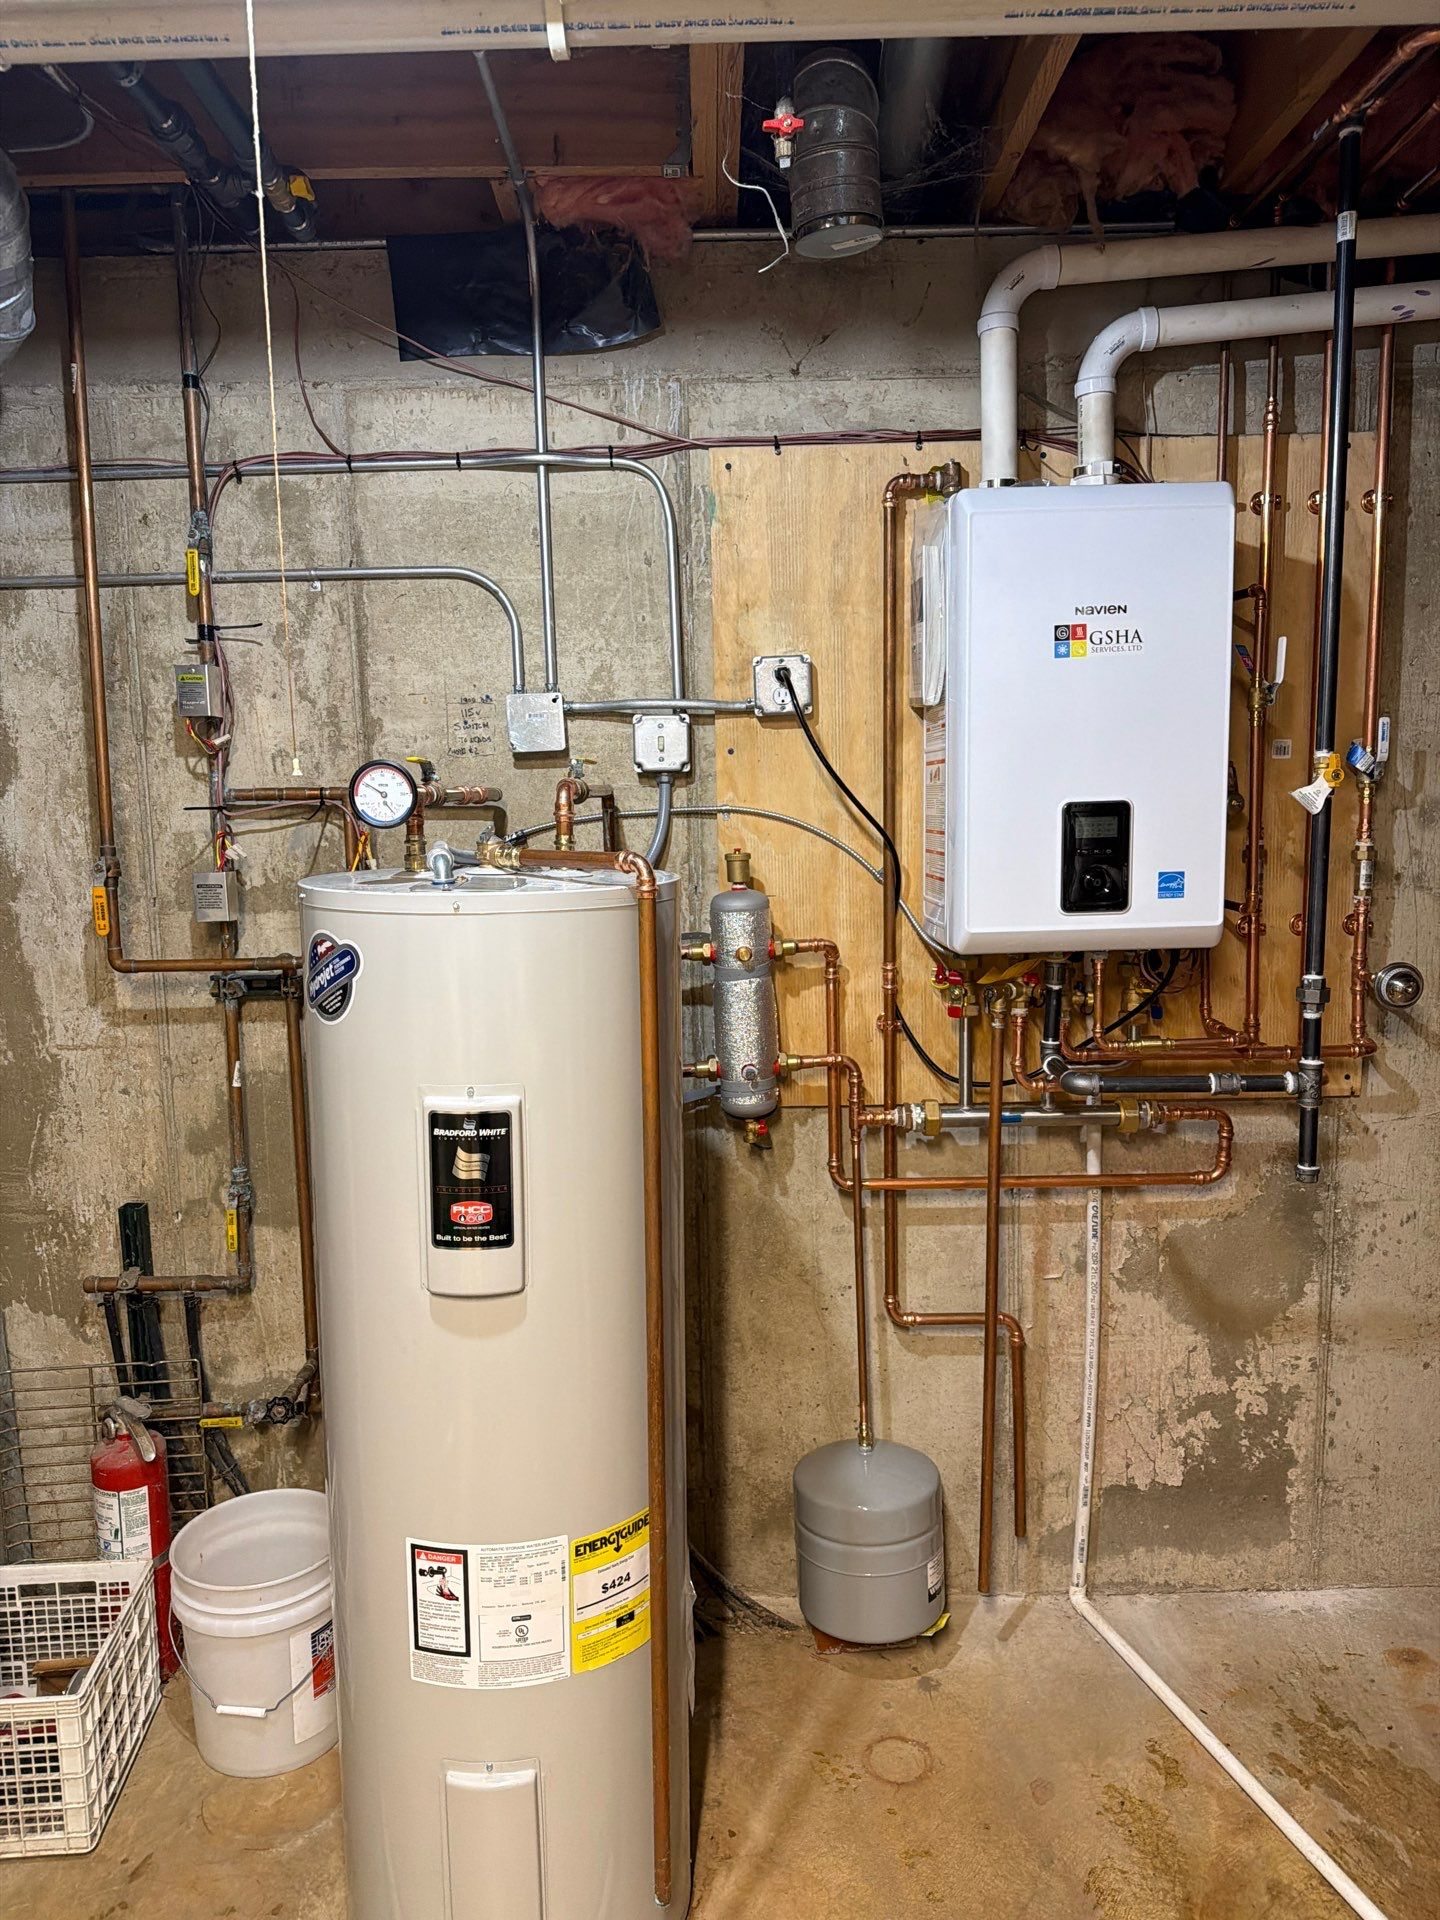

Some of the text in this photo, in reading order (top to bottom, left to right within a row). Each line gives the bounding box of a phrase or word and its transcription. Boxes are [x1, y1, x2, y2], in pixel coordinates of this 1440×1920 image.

[1089, 628, 1143, 646] GSHA
[1128, 644, 1142, 652] LTD
[434, 1128, 506, 1137] BRADFORD WHITE
[453, 1206, 491, 1214] PHCC
[1091, 1266, 1098, 1274] 21
[428, 1554, 456, 1562] DANGER
[601, 1572, 631, 1594] $424
